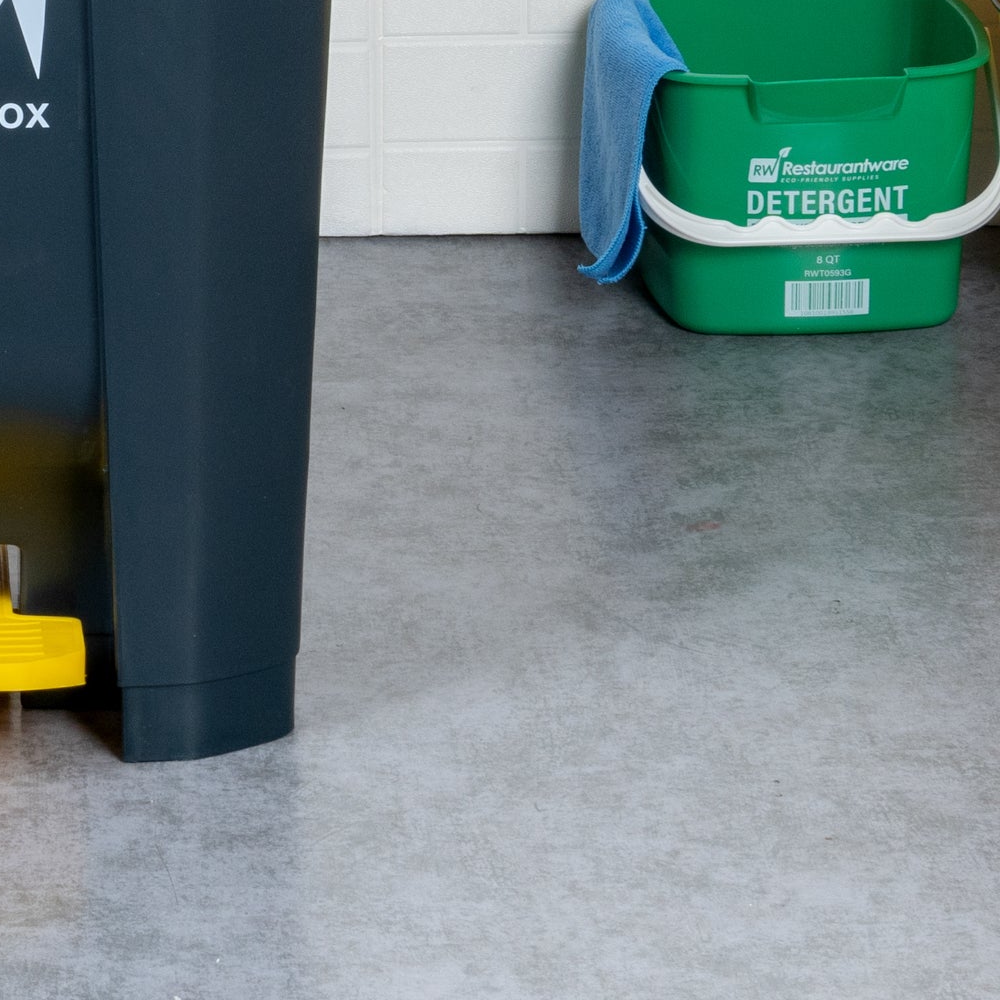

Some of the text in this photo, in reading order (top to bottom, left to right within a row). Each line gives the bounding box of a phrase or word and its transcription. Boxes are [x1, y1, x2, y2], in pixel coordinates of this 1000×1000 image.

[753, 158, 909, 177] RW Restaurantware
[746, 185, 909, 215] DETERGENT
[816, 255, 841, 265] 8 QT
[804, 268, 852, 278] RWT0593G
